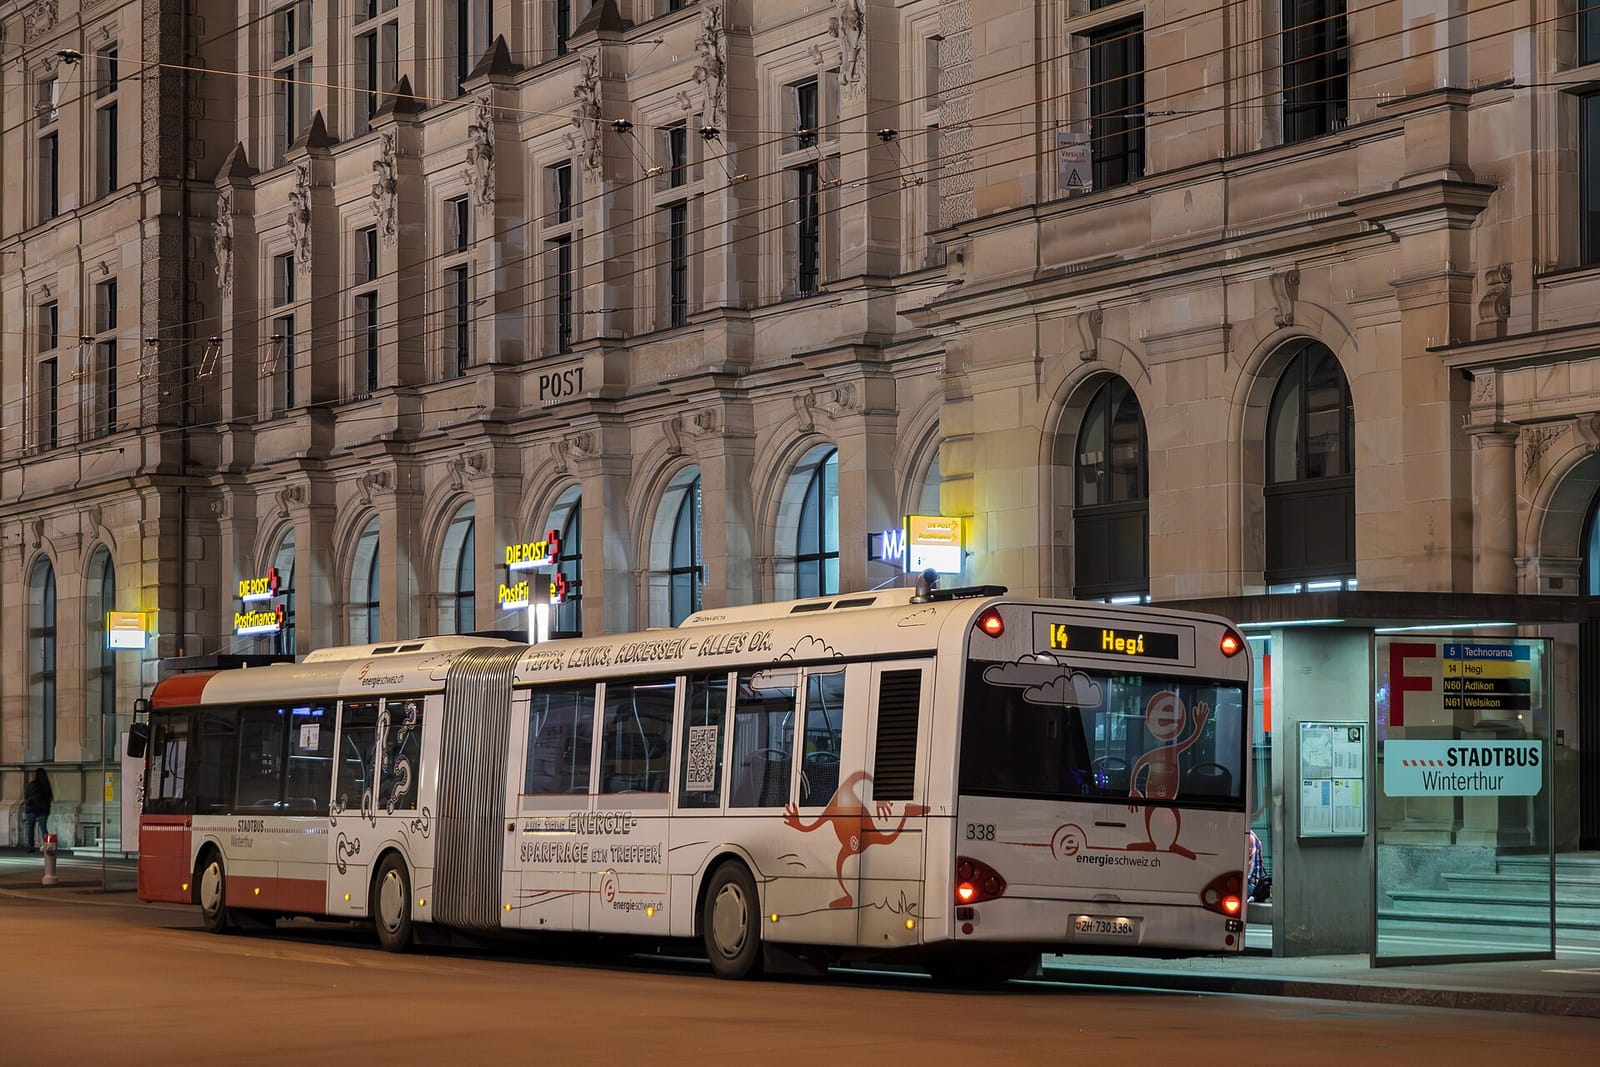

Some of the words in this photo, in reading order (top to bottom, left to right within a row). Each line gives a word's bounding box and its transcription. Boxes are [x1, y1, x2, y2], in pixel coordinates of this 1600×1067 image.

[539, 366, 584, 401] POST
[505, 544, 522, 565] DIE
[522, 541, 548, 561] POST
[239, 580, 250, 597] DIE
[250, 577, 269, 595] POST
[234, 609, 276, 630] PostFinance
[697, 632, 749, 657] ALLES
[1102, 630, 1144, 655] Hegi
[1449, 646, 1456, 656] 5
[1464, 646, 1513, 657] Technorama
[1448, 664, 1457, 673] 14
[1464, 664, 1484, 675] Hegi
[1390, 643, 1436, 727] F
[1444, 681, 1461, 690] N60
[1464, 680, 1495, 691] Adlikon
[1445, 697, 1461, 707] N61
[1464, 697, 1501, 707] Welsikon
[1447, 747, 1539, 767] STADTBUS
[1422, 770, 1504, 791] Winterthur
[237, 819, 264, 833] STADTBUS
[568, 811, 638, 835] ENERGIE-
[966, 824, 996, 841] 338
[520, 841, 590, 864] SPARFRAGE
[591, 847, 608, 863] EIN
[610, 842, 663, 864] TREFFER!
[1076, 854, 1161, 868] energieschweiz.ch
